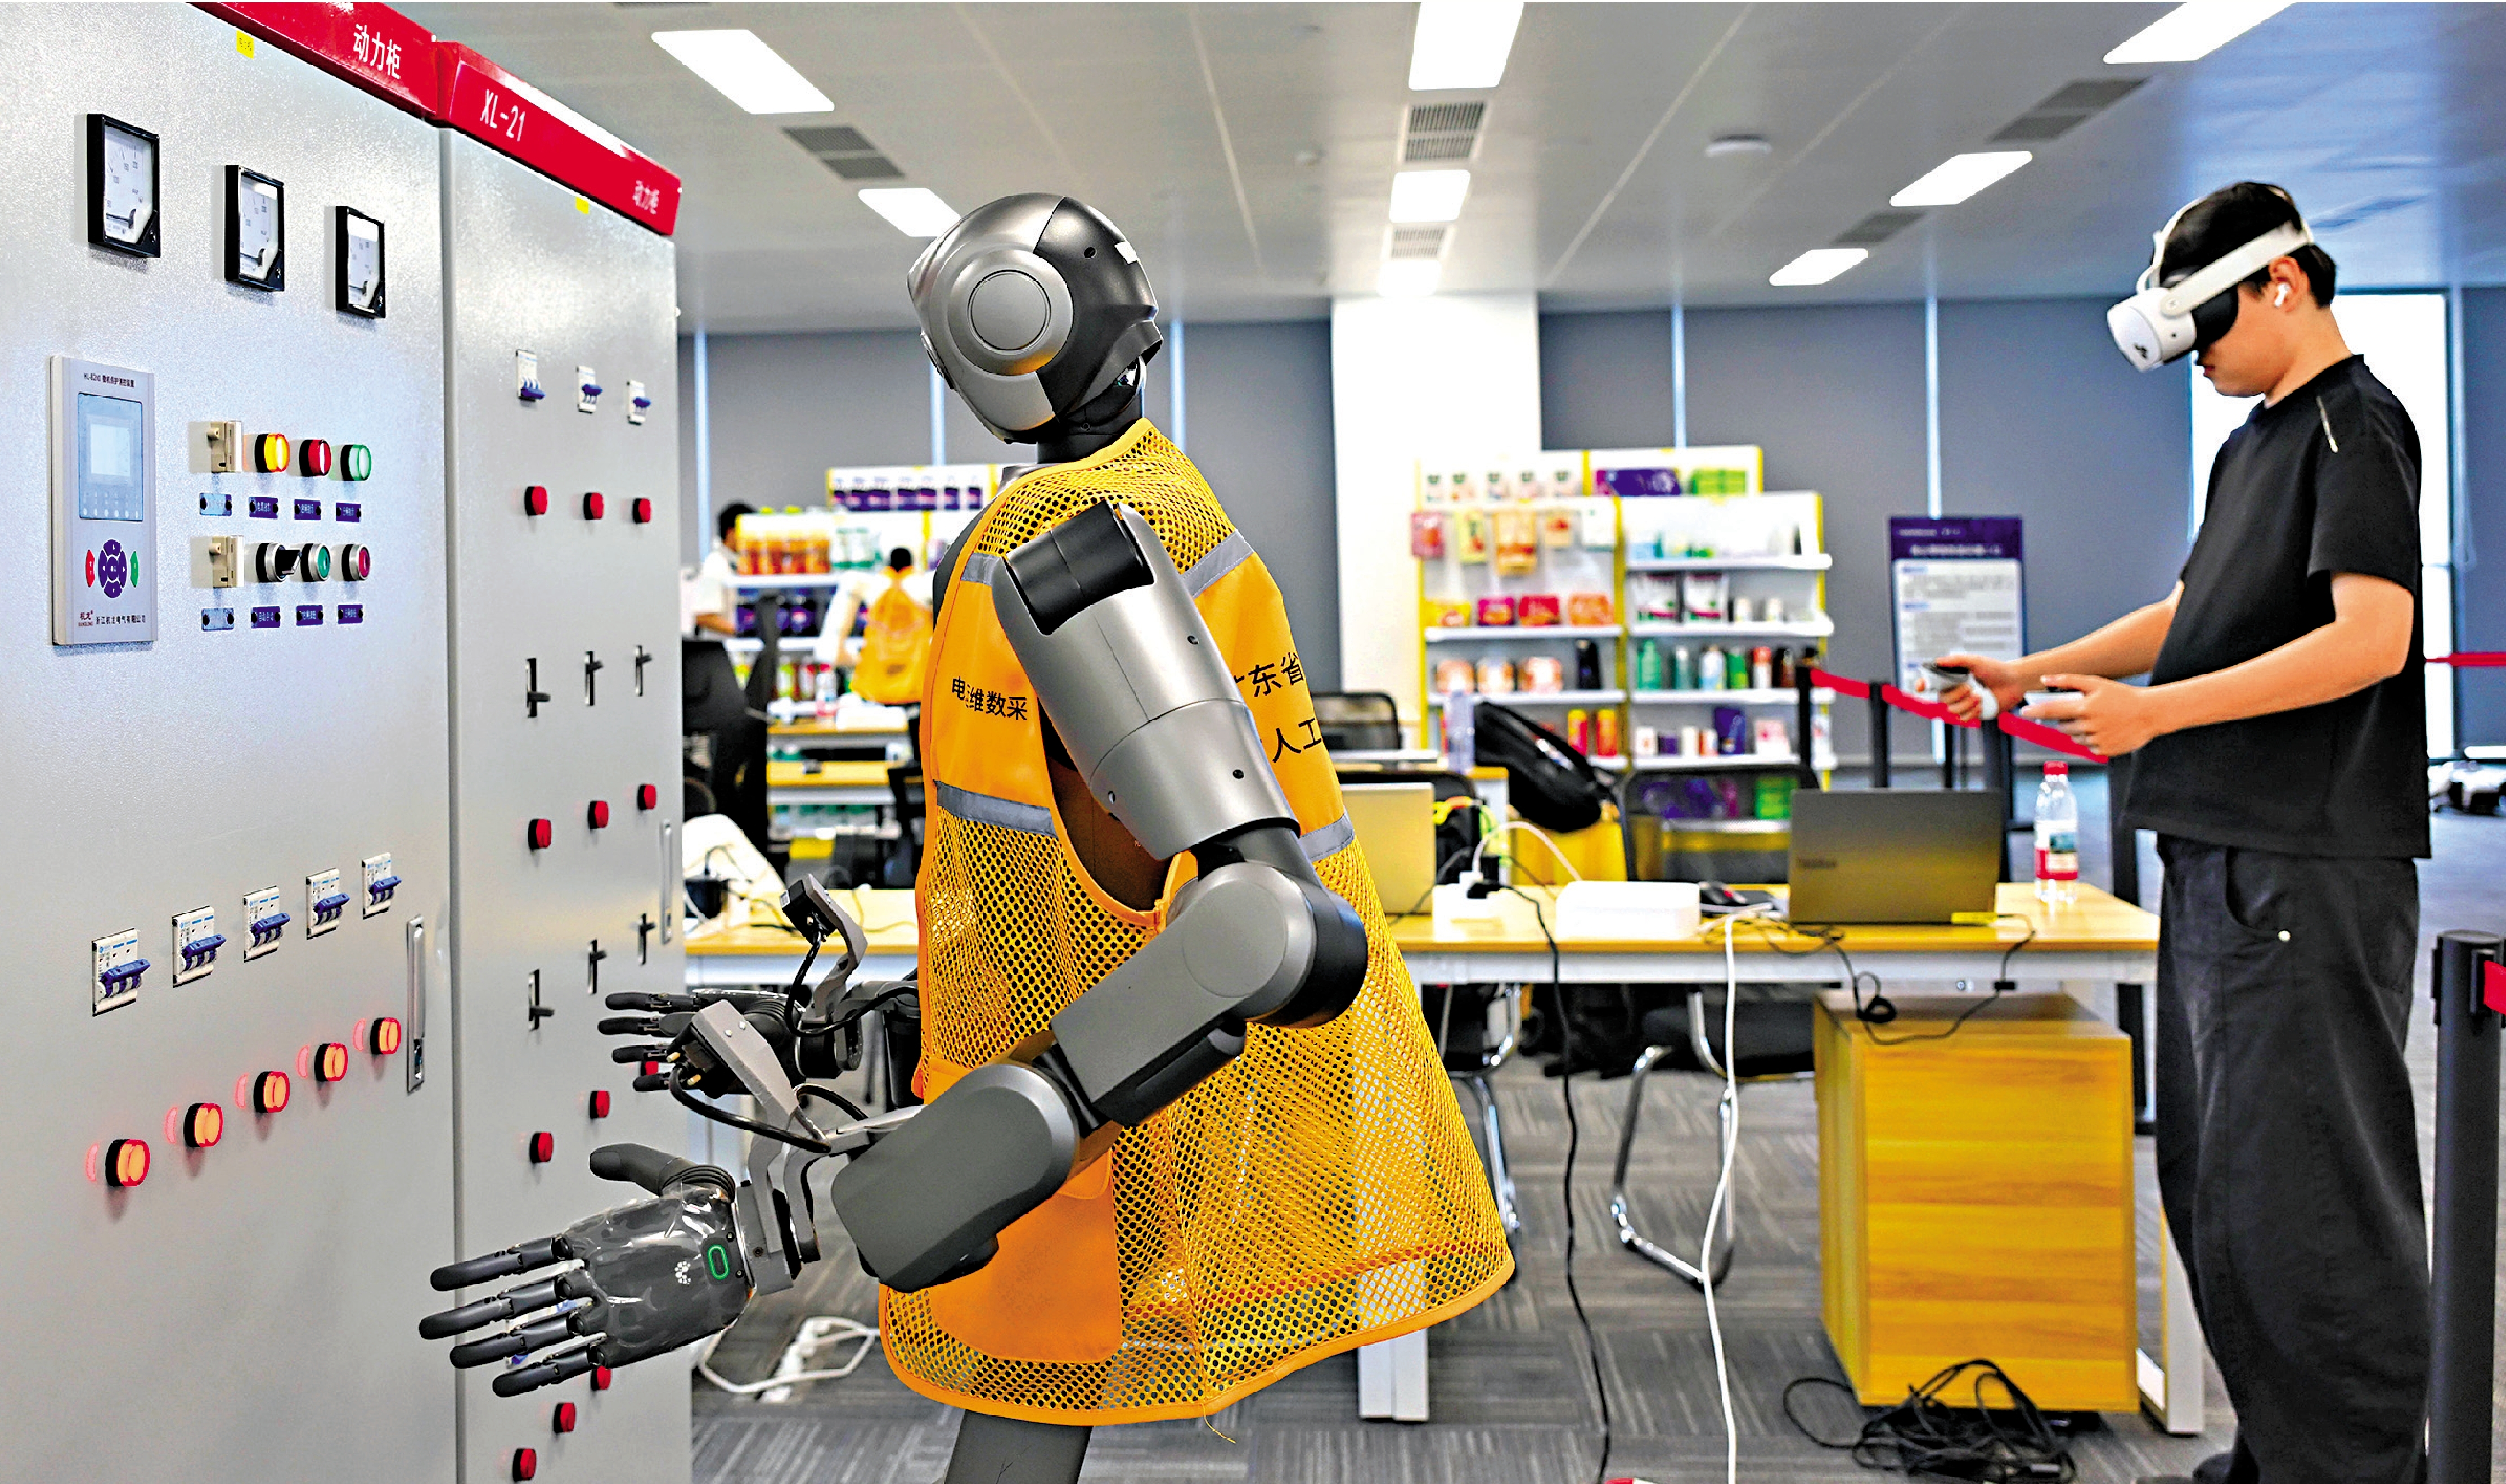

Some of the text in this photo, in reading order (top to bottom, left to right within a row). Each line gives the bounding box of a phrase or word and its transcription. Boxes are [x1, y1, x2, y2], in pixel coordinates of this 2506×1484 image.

[353, 24, 402, 79] 动力柜
[480, 89, 526, 142] XL-21
[1271, 717, 1322, 763] 人工
